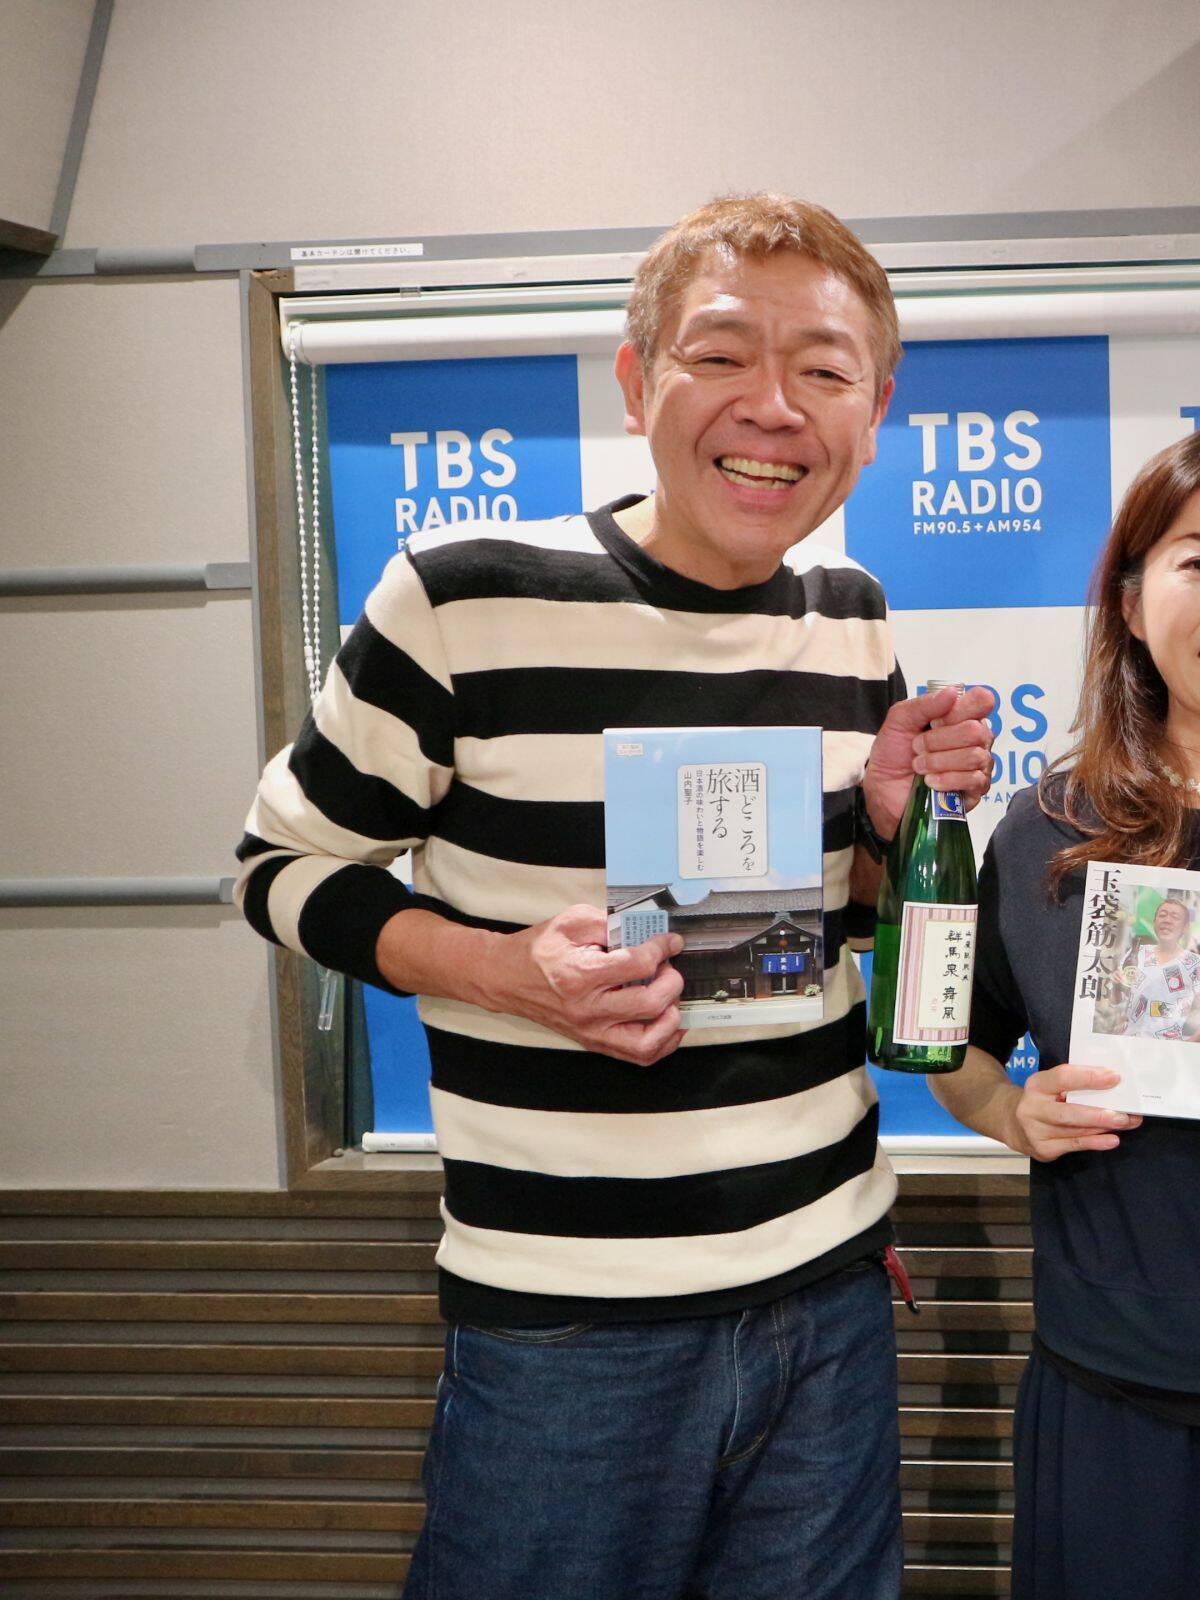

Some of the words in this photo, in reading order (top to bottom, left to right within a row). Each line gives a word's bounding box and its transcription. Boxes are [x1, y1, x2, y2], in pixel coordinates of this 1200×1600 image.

[390, 428, 517, 492] TBS
[908, 409, 1042, 475] TBS
[395, 494, 518, 532] RADIO
[912, 477, 1042, 516] RADIO
[917, 683, 1048, 743] BS
[989, 750, 1048, 785] DIO
[706, 768, 733, 839] 旅する
[735, 768, 761, 871] 酒どころを
[1079, 869, 1122, 1002] 玉袋筋太郎
